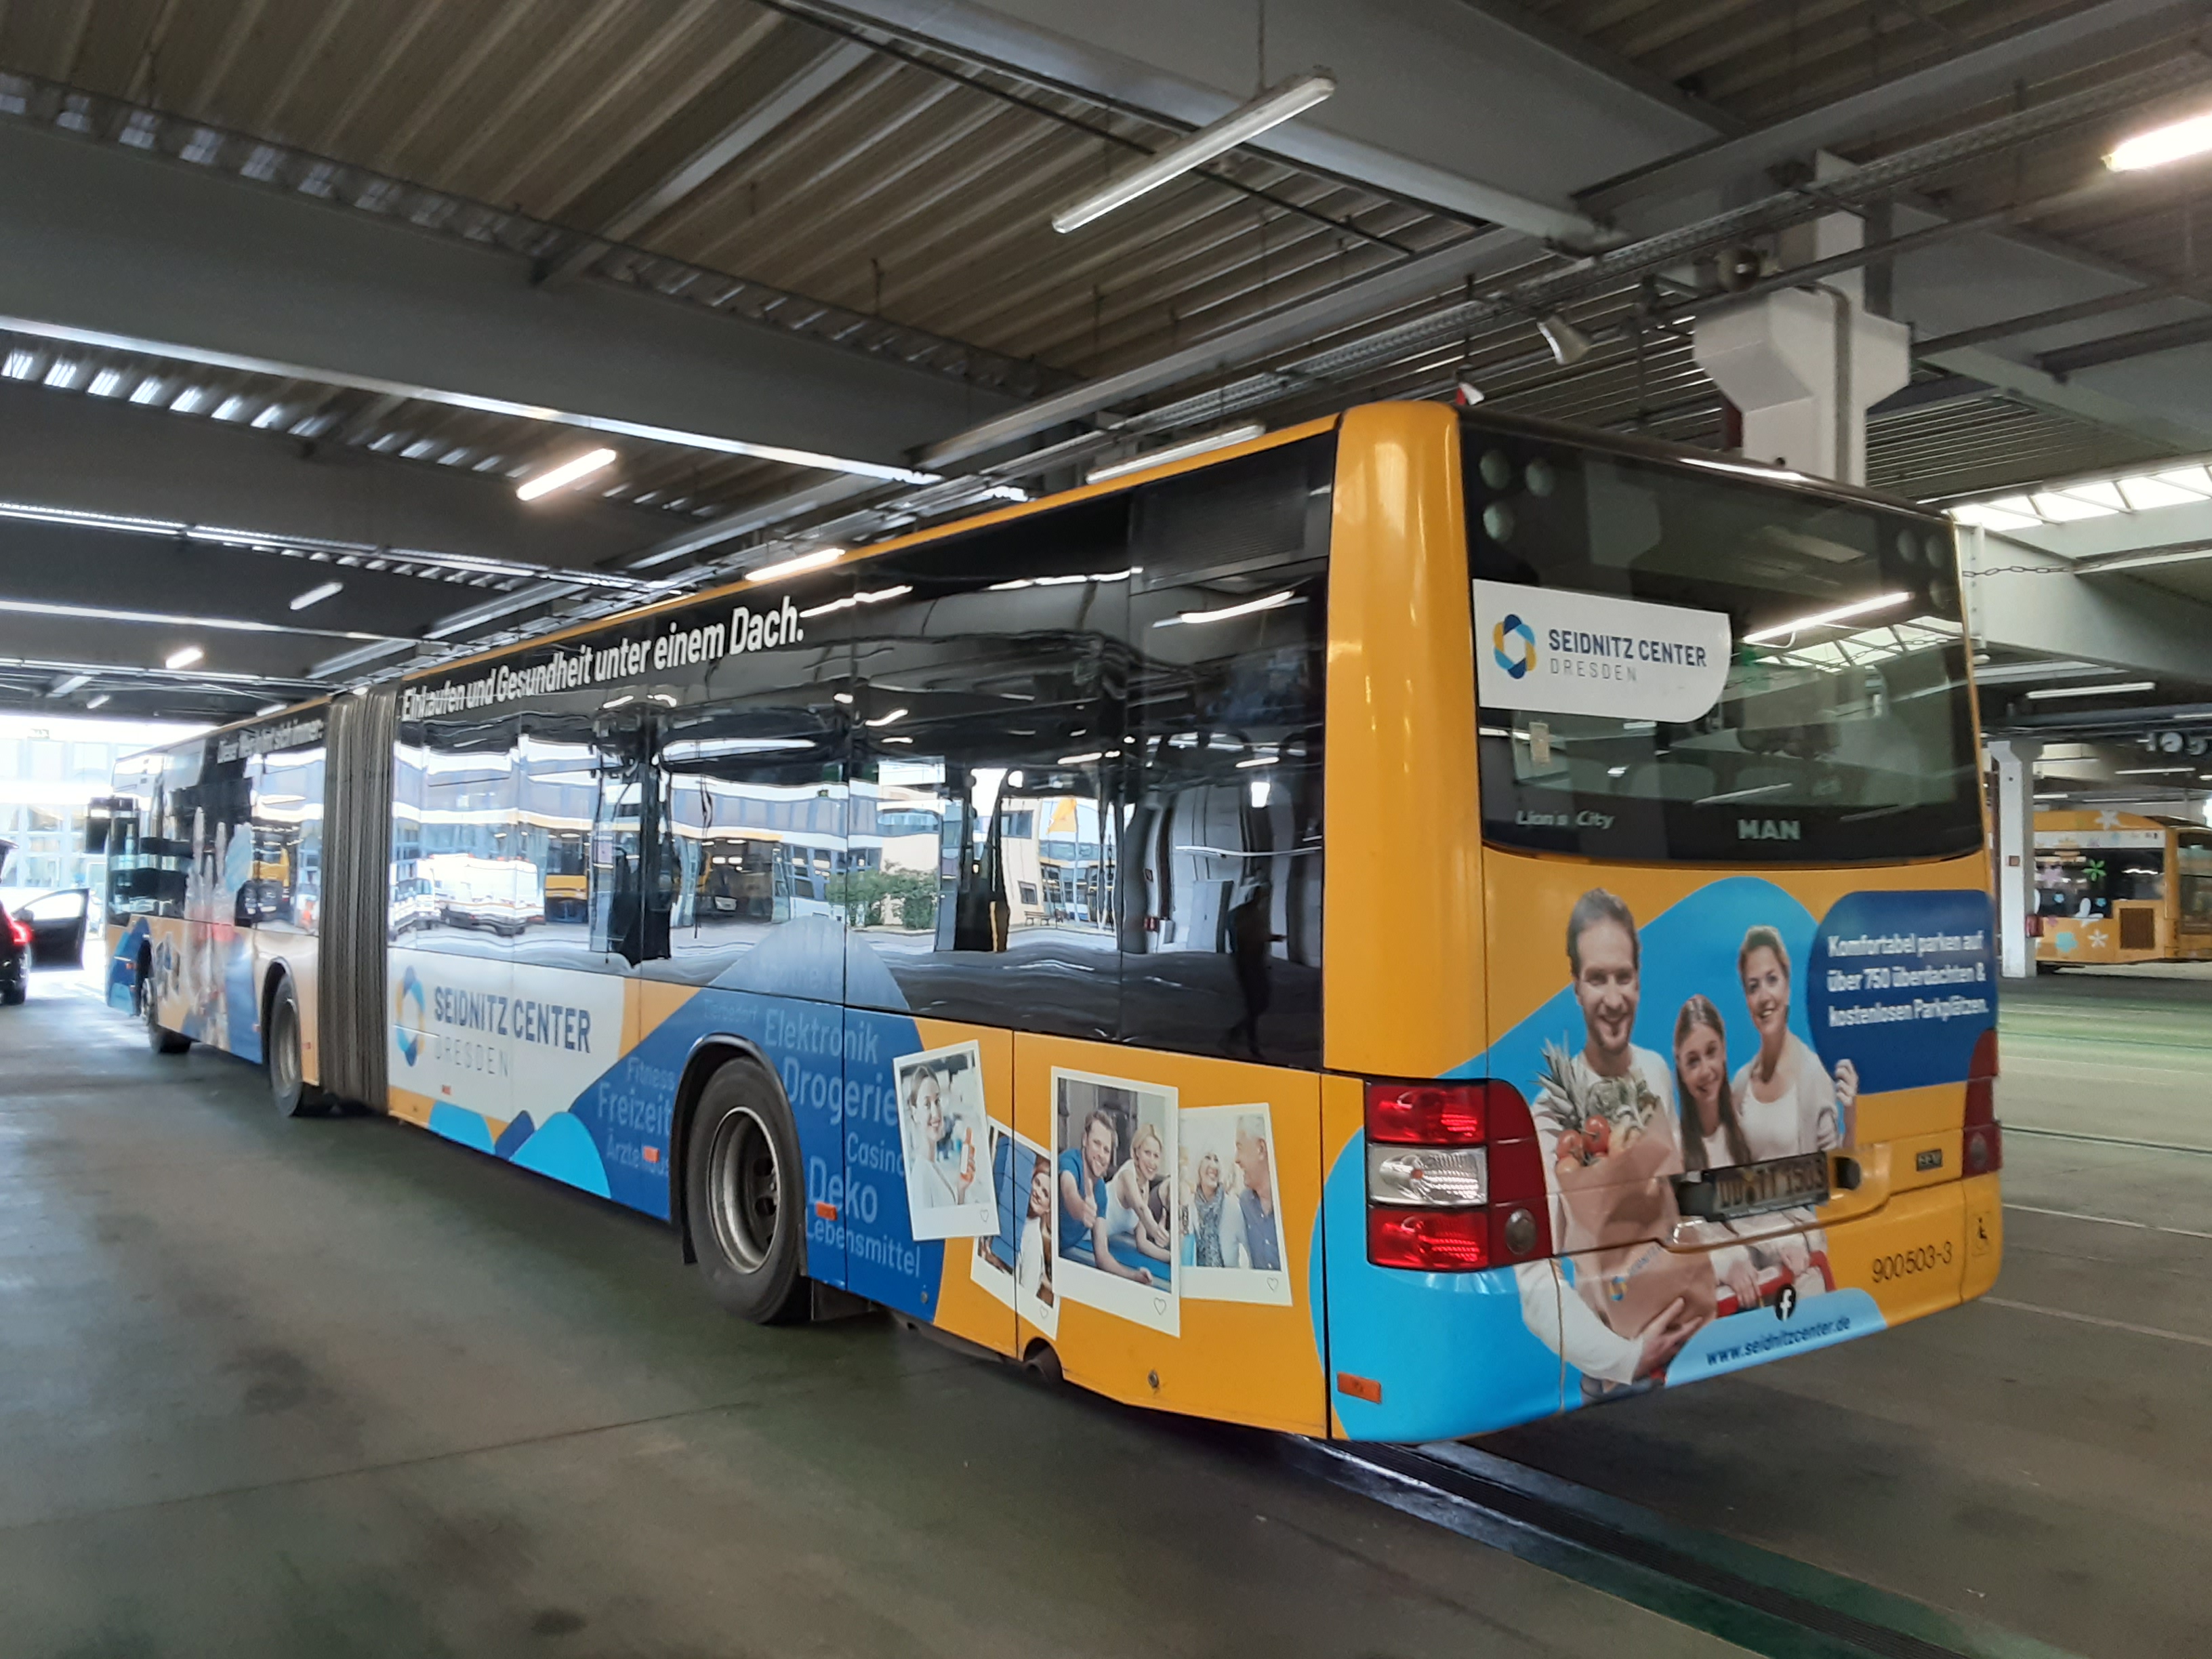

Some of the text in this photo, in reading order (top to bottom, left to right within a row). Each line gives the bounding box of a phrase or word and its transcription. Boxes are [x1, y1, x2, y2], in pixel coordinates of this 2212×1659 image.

[402, 595, 804, 721] Einkaufen und Gesundheit unter einem Dach.
[1549, 628, 1708, 669] SEIDNITZ CENTER
[1549, 658, 1637, 682] DRESDEN
[1576, 809, 1616, 831] City
[1738, 818, 1801, 842] MAN
[1827, 929, 1985, 958] Komfortabel parken auf
[1864, 967, 1891, 990] 750
[1891, 964, 1975, 987] überdachten
[1975, 962, 1986, 982] &
[434, 985, 592, 1054] SEIDNITZ CENTER
[764, 1008, 879, 1065] Elektronik
[1828, 1001, 1913, 1028] kostenlosen
[434, 1033, 510, 1078] DRESDEN
[626, 1056, 676, 1092] Fitness
[597, 1080, 672, 1137] Freizeit
[783, 1057, 899, 1126] Drogerie
[808, 1155, 878, 1224] Deko
[805, 1206, 921, 1278] Lebensmittel
[1871, 1241, 1954, 1284] 900503-3
[1705, 1315, 1851, 1367] www.seidnitzcenter.de
